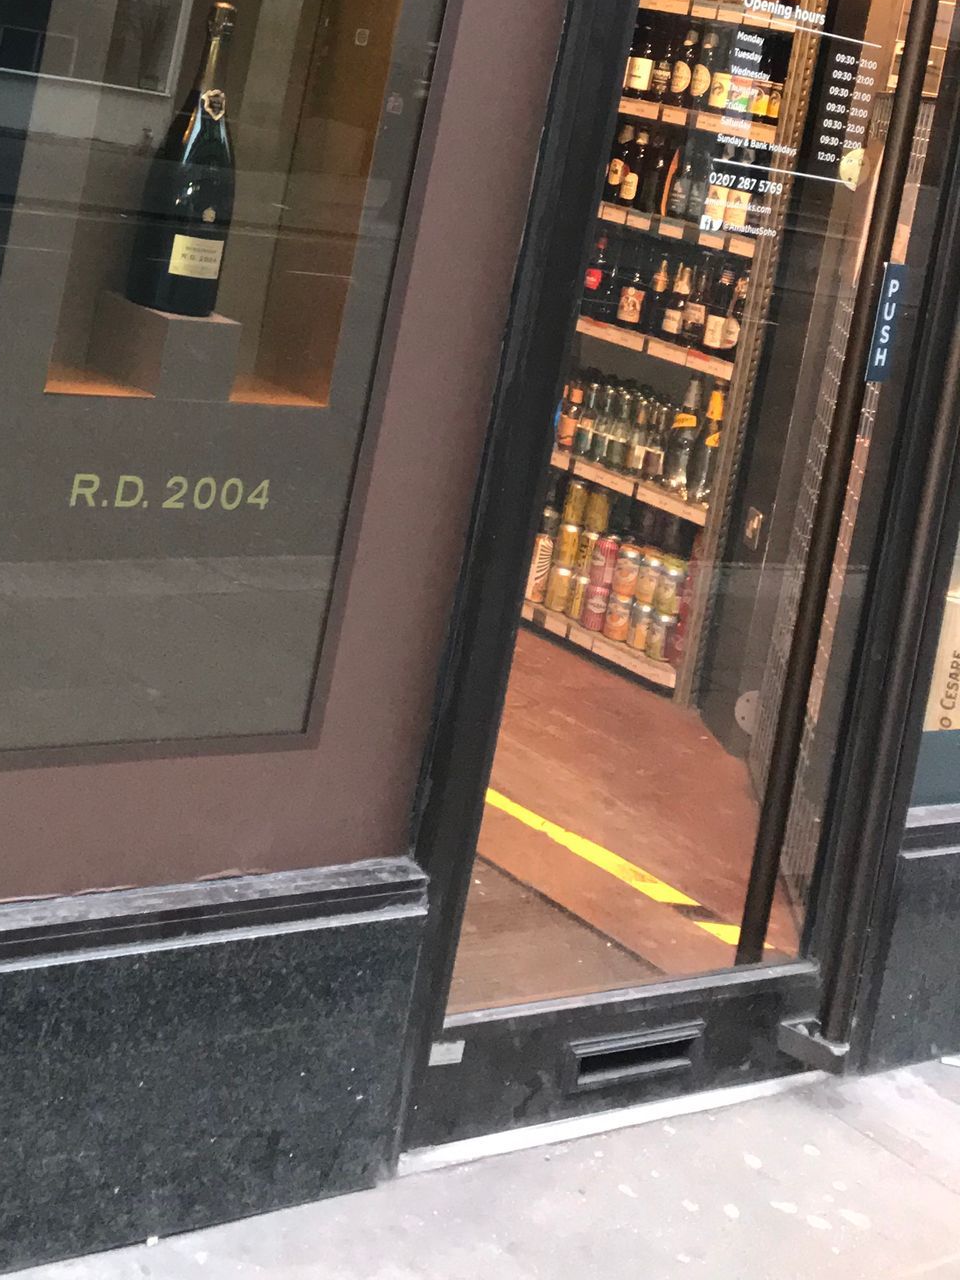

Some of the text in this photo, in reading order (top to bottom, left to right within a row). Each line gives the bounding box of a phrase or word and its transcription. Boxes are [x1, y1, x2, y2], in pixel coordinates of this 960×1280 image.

[794, 4, 826, 26] hours
[737, 31, 765, 46] Monday
[734, 48, 762, 63] Tuesday
[835, 53, 855, 66] 09:30
[860, 59, 878, 70] 21:00
[731, 65, 770, 81] Wednesday
[832, 69, 852, 82] 09:30
[856, 75, 874, 86] 21:00
[829, 86, 849, 98] 09:30
[826, 102, 846, 114] 09:30
[850, 107, 868, 118] 21:00
[823, 118, 842, 130] 09:30
[846, 123, 865, 134] 22:00
[717, 133, 743, 147] Sunday
[750, 139, 768, 150] Bank
[768, 143, 797, 157] Holidays
[820, 135, 839, 147] 09:30
[843, 139, 862, 150] 22:00
[817, 151, 836, 163] 12:00
[709, 171, 783, 195] 0207 287 5769
[874, 278, 901, 367] PUSH
[69, 473, 270, 511] R.D. 2004
